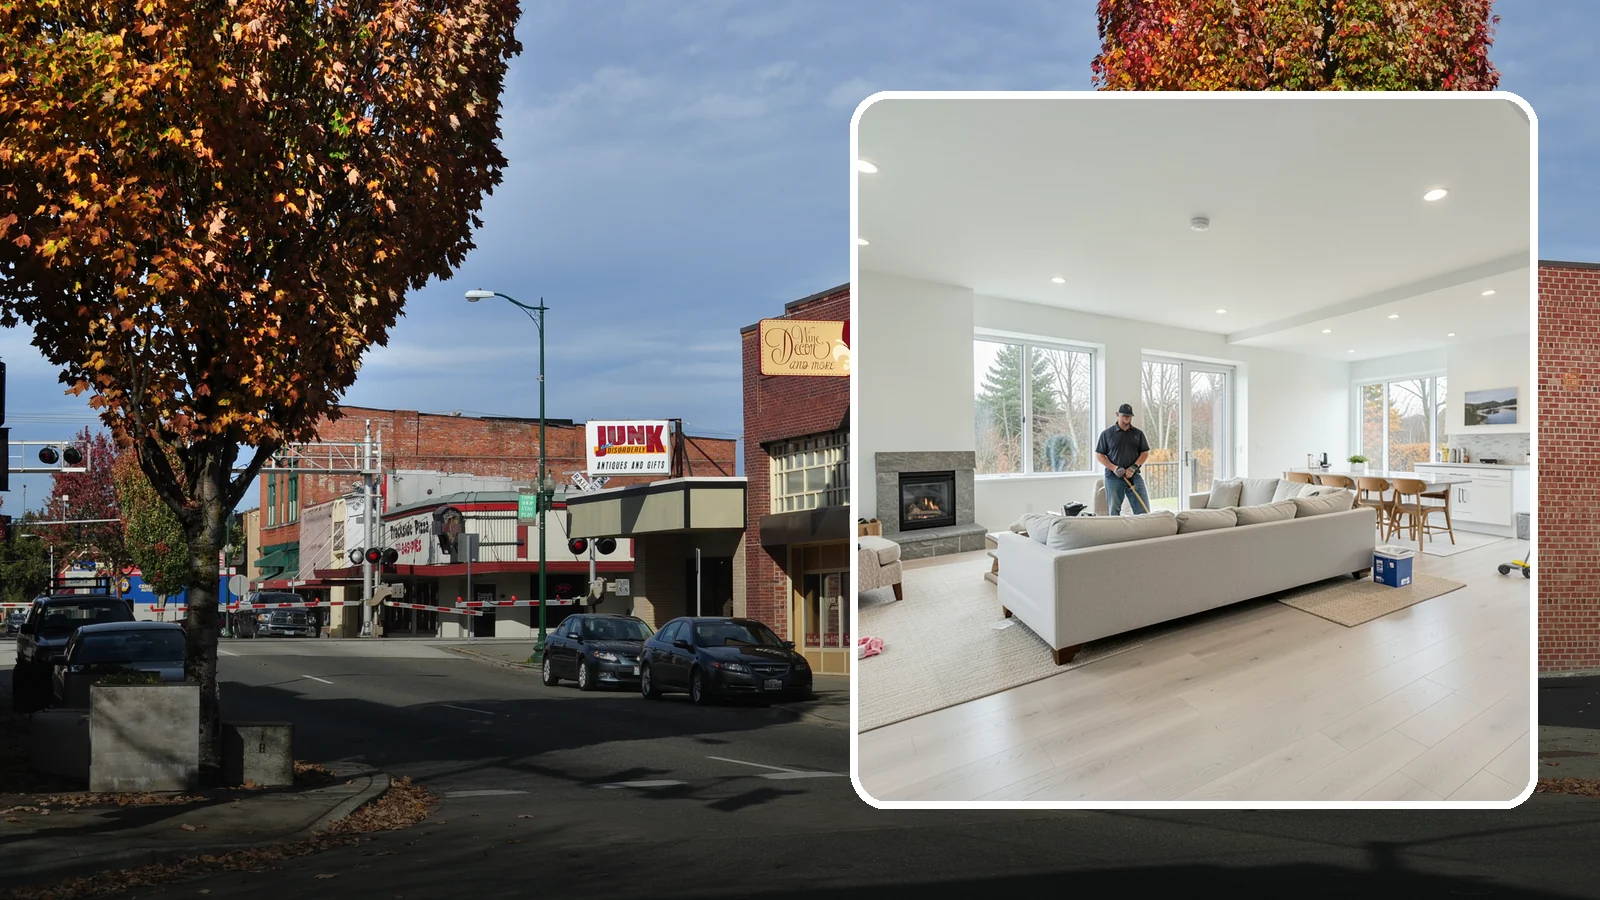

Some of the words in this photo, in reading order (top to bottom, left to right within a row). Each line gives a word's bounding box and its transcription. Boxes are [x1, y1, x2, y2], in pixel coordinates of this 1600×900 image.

[595, 425, 665, 457] JUNK
[607, 446, 646, 454] DISORDERLY
[597, 461, 628, 470] ANTIQUES
[631, 461, 644, 470] AND
[647, 460, 665, 470] GIFTS
[390, 521, 413, 539] Trackside
[414, 519, 429, 535] Pizza
